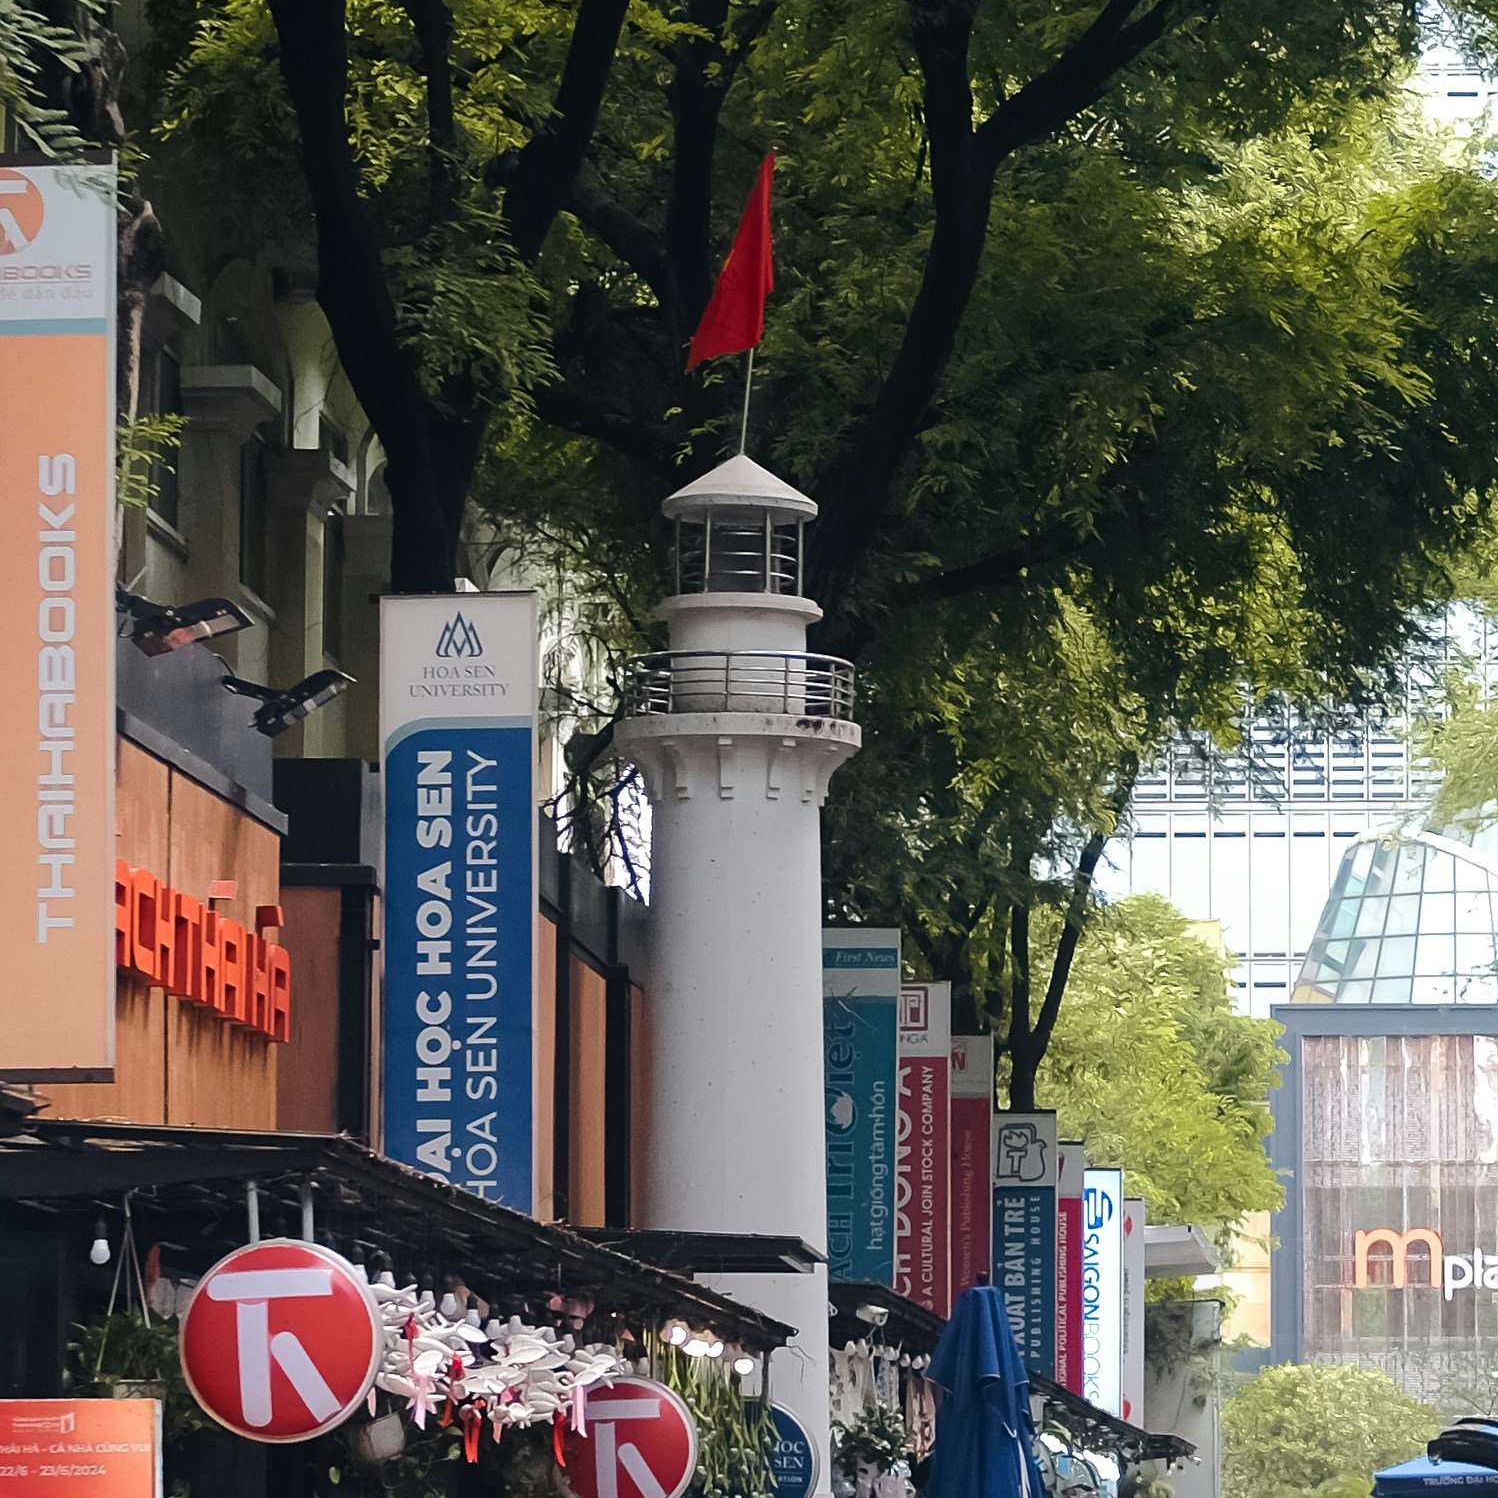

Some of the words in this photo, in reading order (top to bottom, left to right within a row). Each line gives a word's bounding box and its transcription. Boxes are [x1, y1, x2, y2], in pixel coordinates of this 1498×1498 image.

[408, 683, 510, 698] UNIVERSITY
[423, 666, 461, 679] HOA
[464, 665, 497, 679] SEN
[415, 750, 453, 849] SEN
[465, 749, 498, 1001] UNIVERSITY
[415, 860, 453, 976] HOA
[415, 990, 462, 1102] HỌC
[465, 1017, 498, 1100] SEN
[921, 1065, 934, 1136] COMPANY
[921, 1139, 934, 1183] STOCK
[921, 1185, 934, 1217] JOIN
[1030, 1196, 1041, 1245] HOUSE
[921, 1219, 934, 1283] CULTURAL
[1030, 1257, 1042, 1358] PUBLISHING
